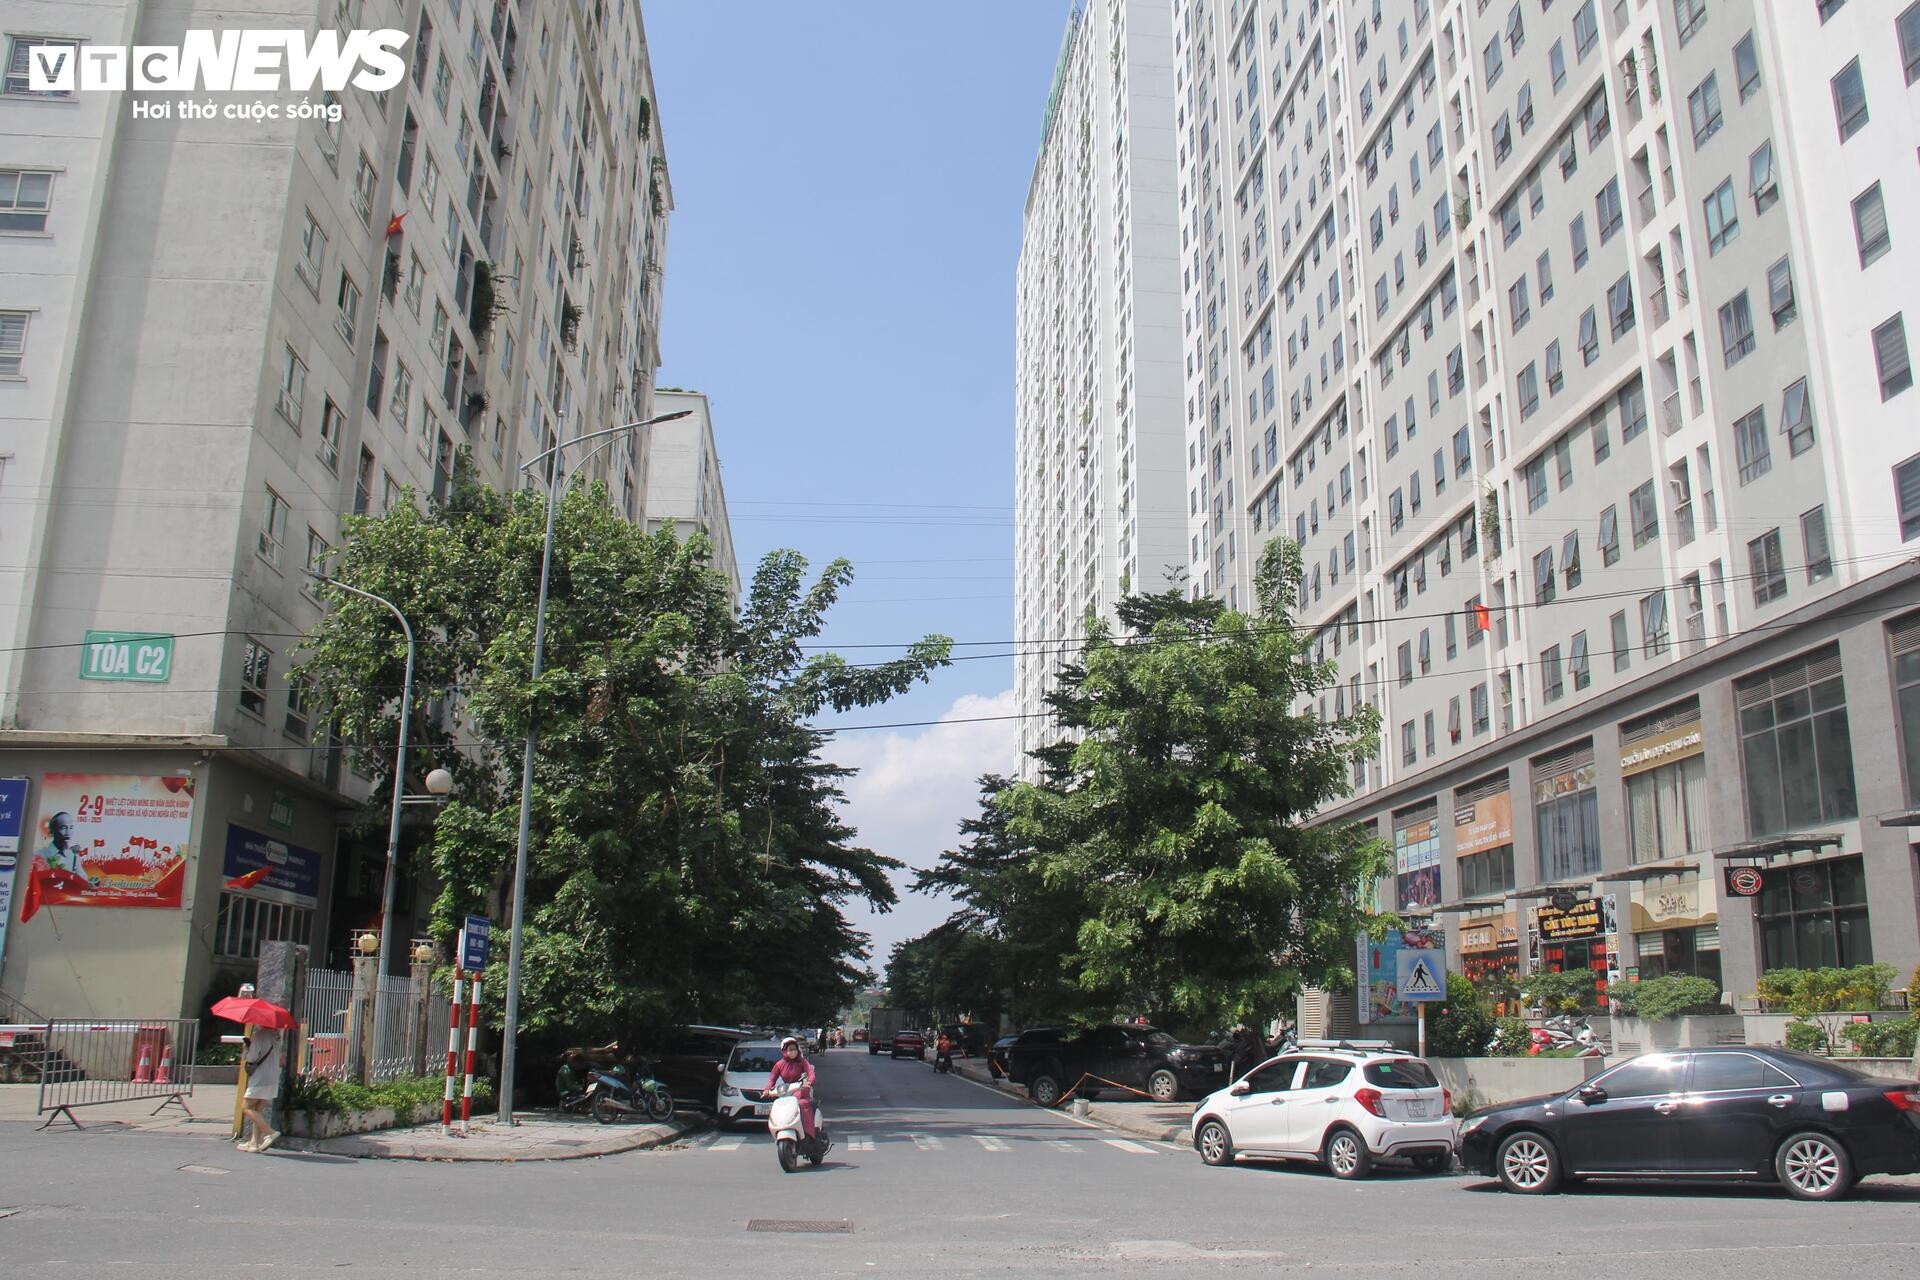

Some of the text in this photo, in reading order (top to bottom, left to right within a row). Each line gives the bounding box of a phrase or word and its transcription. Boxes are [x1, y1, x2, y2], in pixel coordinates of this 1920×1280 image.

[90, 637, 165, 675] TÒA C2
[78, 794, 104, 816] 2-9
